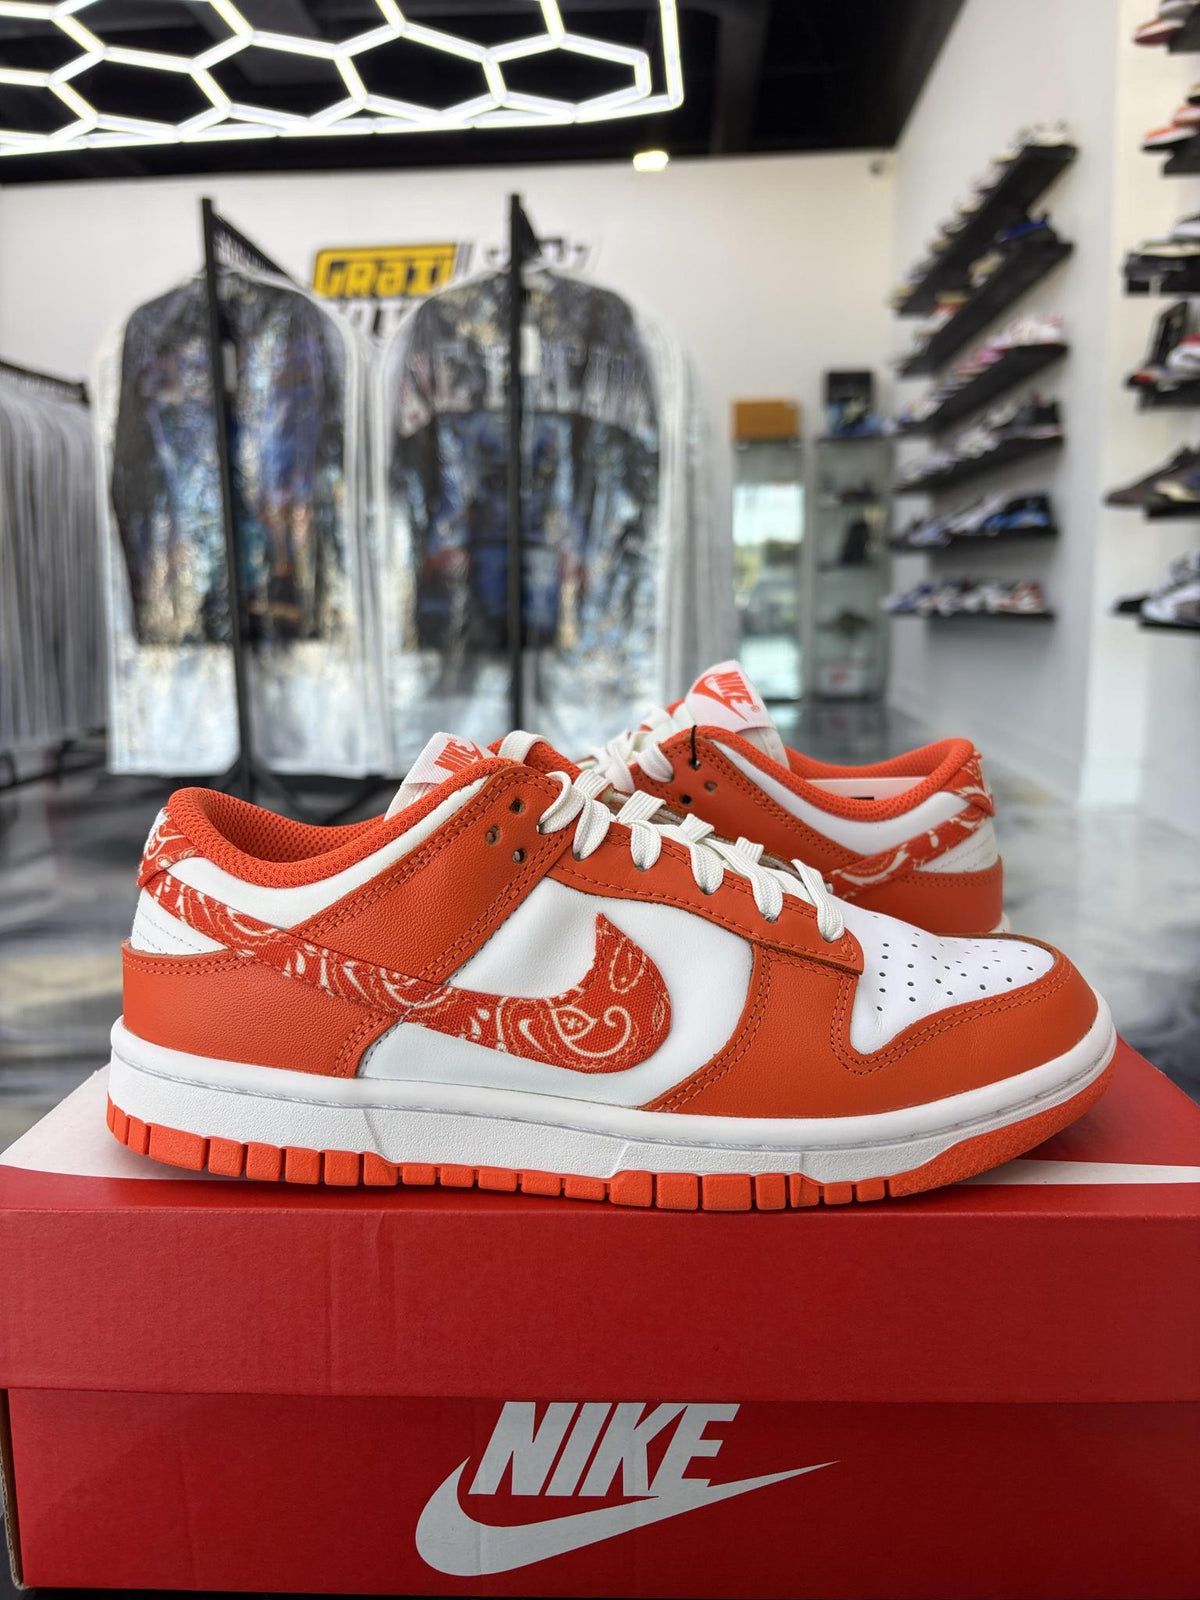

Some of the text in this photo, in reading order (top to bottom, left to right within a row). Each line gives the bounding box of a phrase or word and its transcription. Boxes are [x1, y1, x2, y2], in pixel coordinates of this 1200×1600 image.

[713, 671, 755, 705] NIKE
[433, 741, 478, 773] NIKE
[468, 1401, 741, 1498] NIKE
